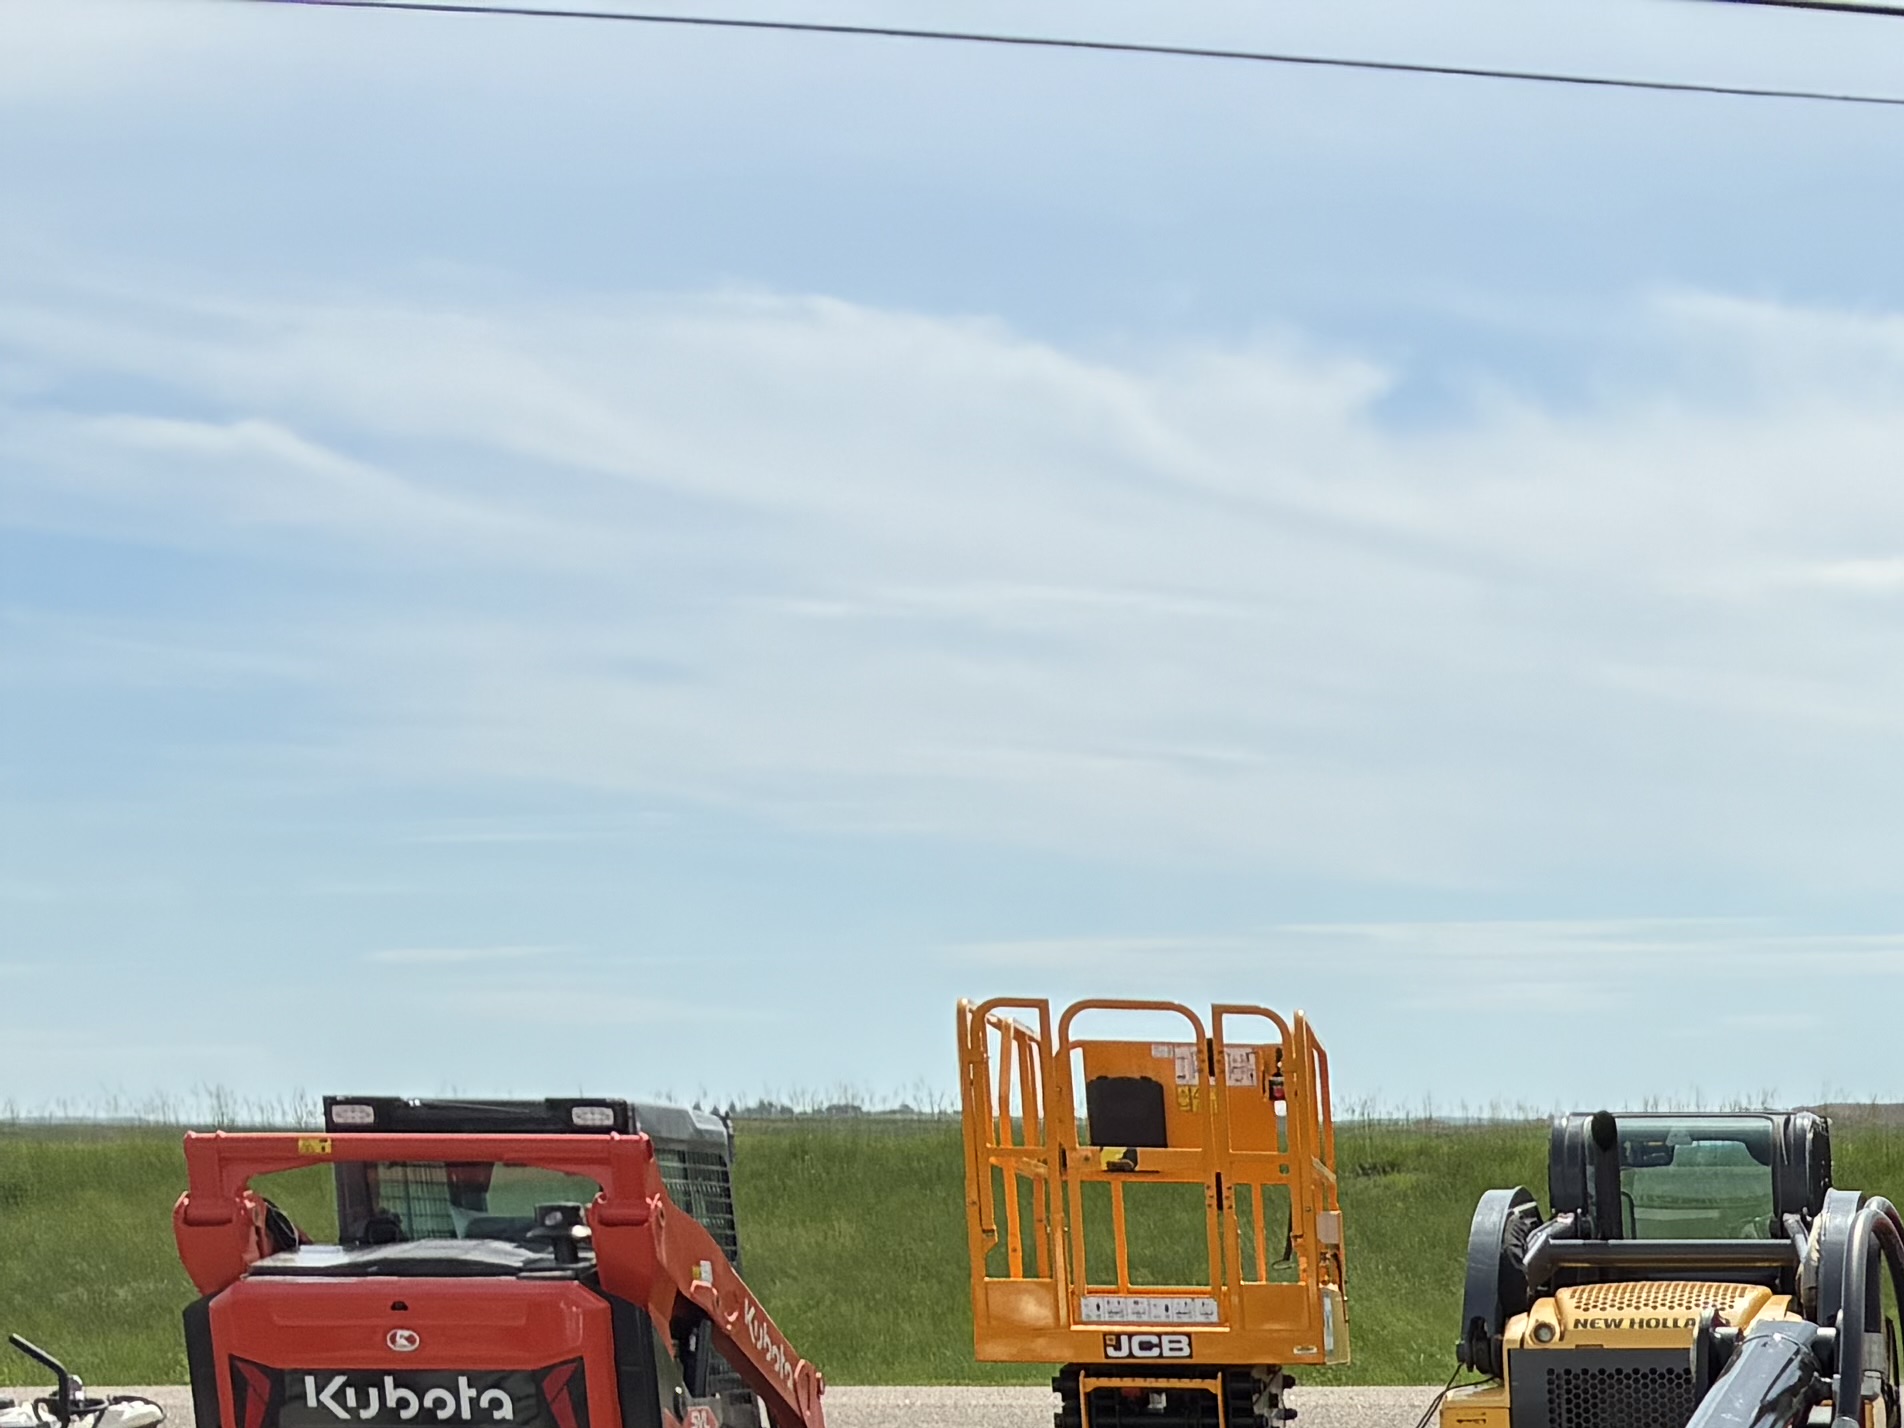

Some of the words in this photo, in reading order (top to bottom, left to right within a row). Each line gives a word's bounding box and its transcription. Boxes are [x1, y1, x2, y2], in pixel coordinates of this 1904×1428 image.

[1573, 1317, 1625, 1329] NEW
[1628, 1317, 1730, 1330] HOLLA
[744, 1298, 794, 1392] Kubota
[1106, 1334, 1191, 1358] JCB
[304, 1375, 514, 1420] Kubota
